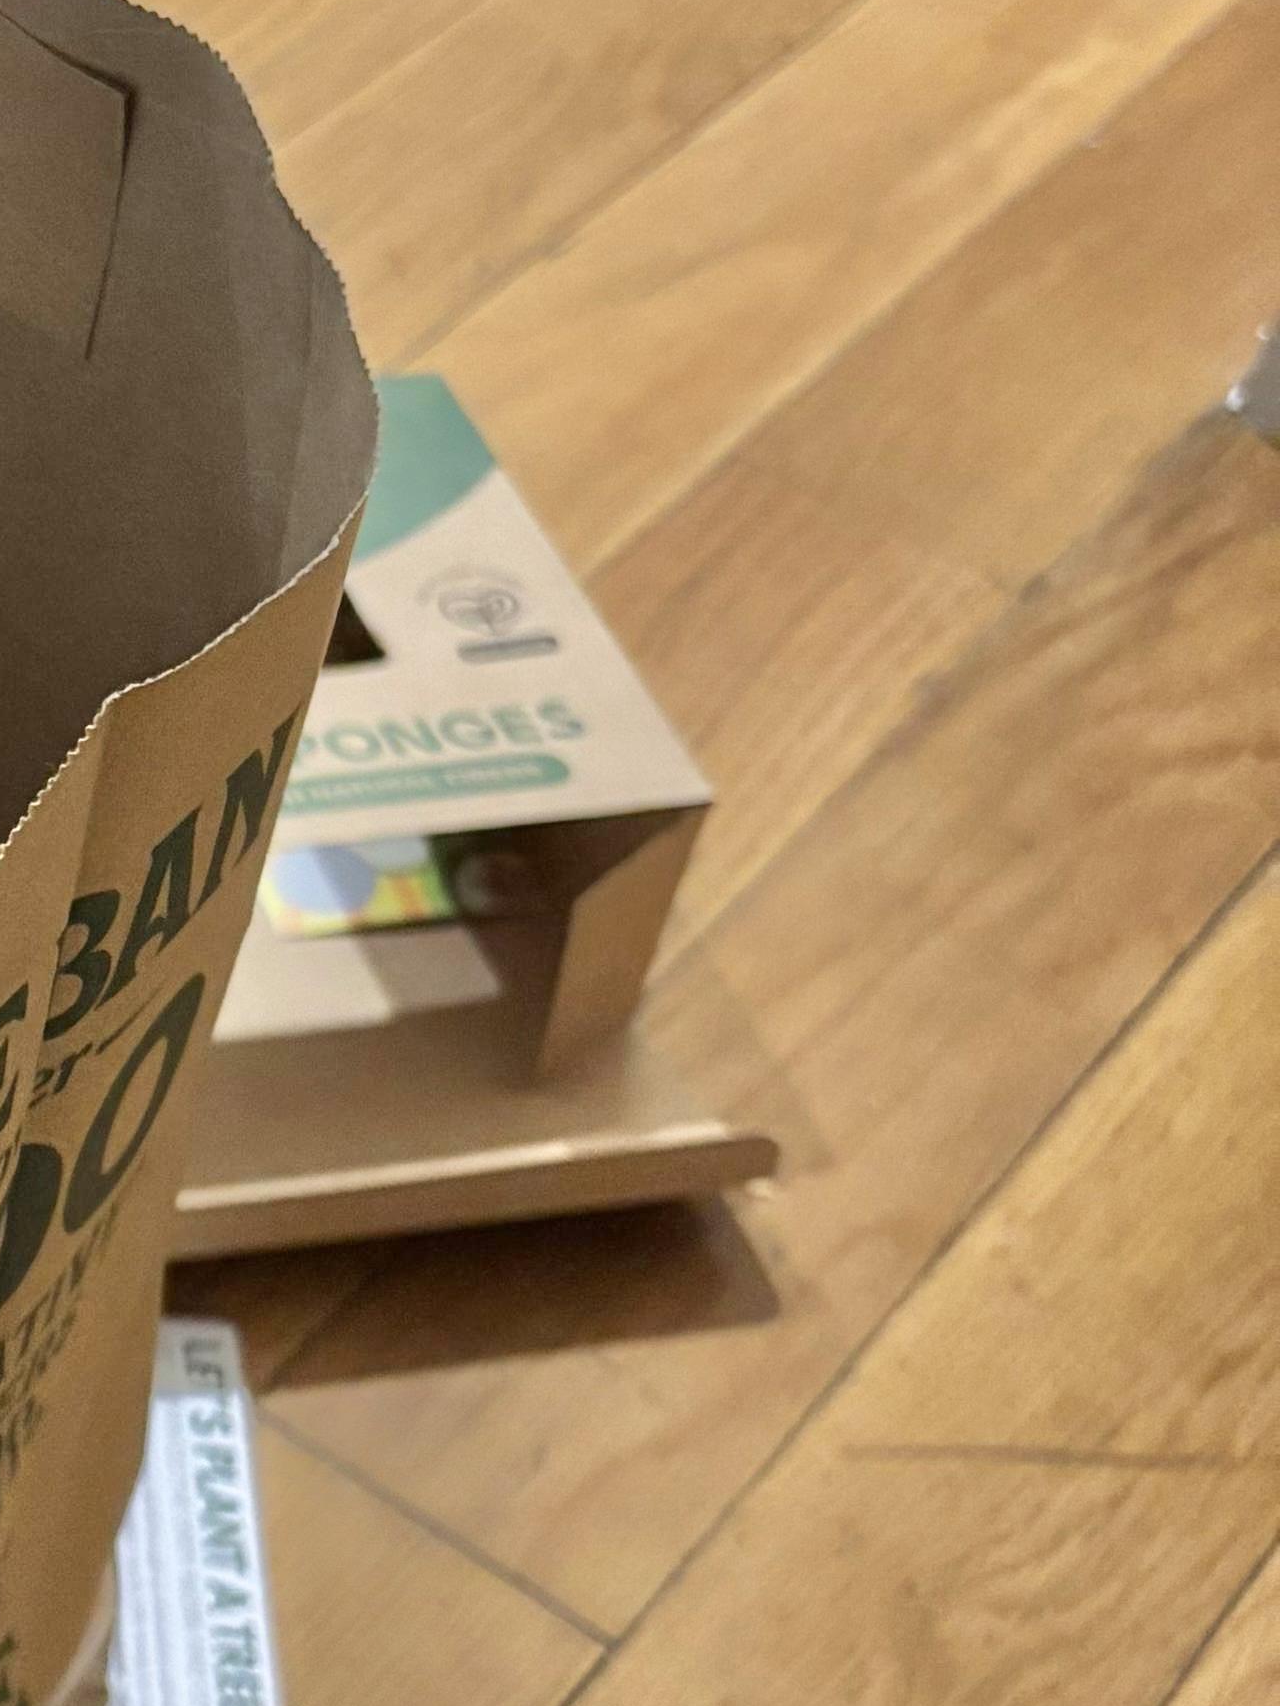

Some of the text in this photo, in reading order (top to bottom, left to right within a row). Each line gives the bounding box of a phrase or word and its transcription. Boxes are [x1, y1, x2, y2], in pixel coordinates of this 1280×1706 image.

[44, 701, 304, 1042] BAN
[192, 1444, 249, 1576] PLANT
[207, 1579, 249, 1611] A
